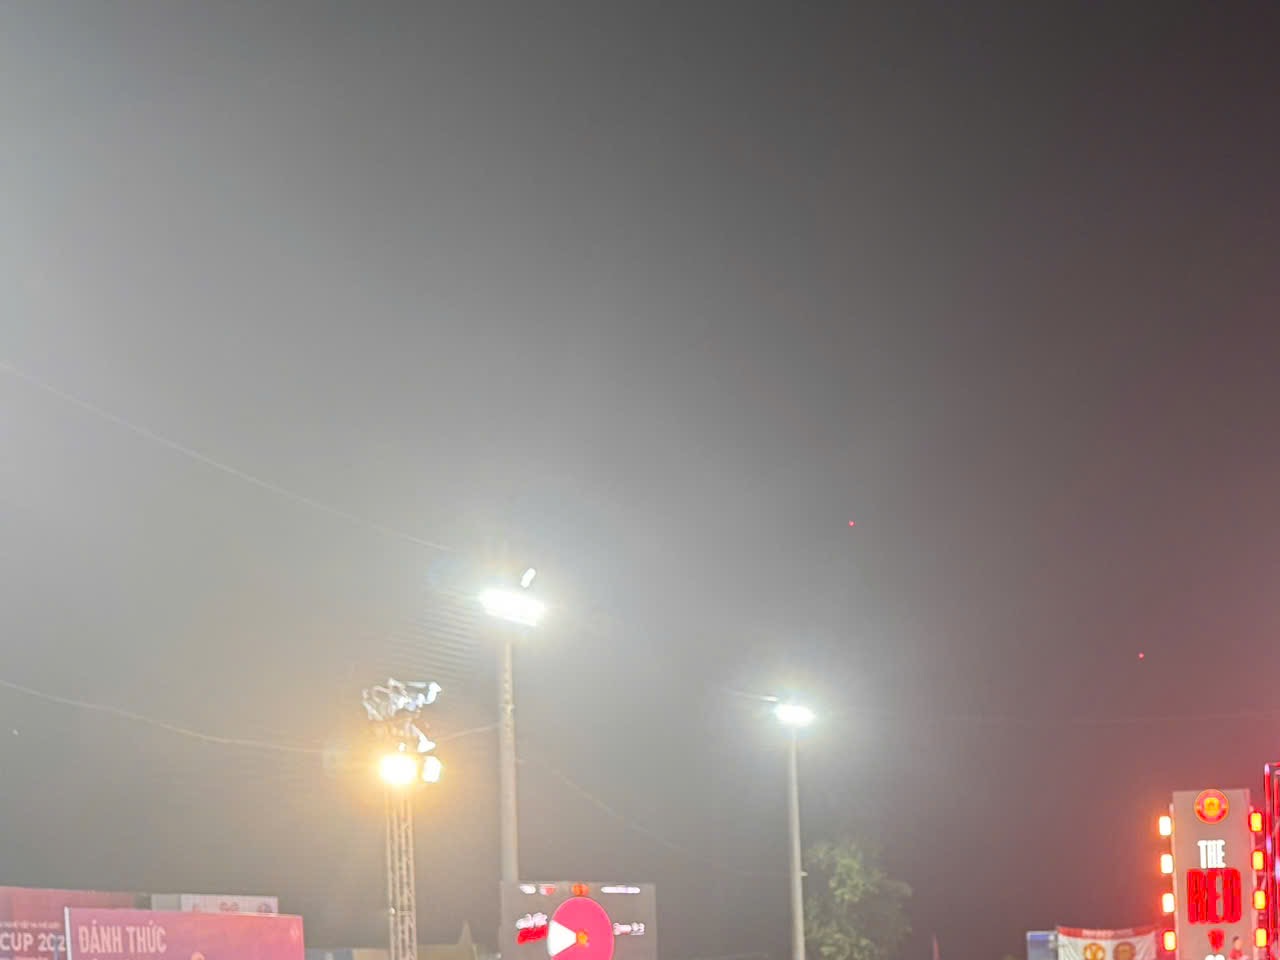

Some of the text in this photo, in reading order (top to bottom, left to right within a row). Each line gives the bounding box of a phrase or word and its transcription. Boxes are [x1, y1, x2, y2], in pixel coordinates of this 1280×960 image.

[1197, 839, 1226, 869] THE
[1187, 867, 1242, 925] RED
[0, 933, 66, 951] CUP 202
[79, 920, 167, 954] ĐÁNH THỨC
